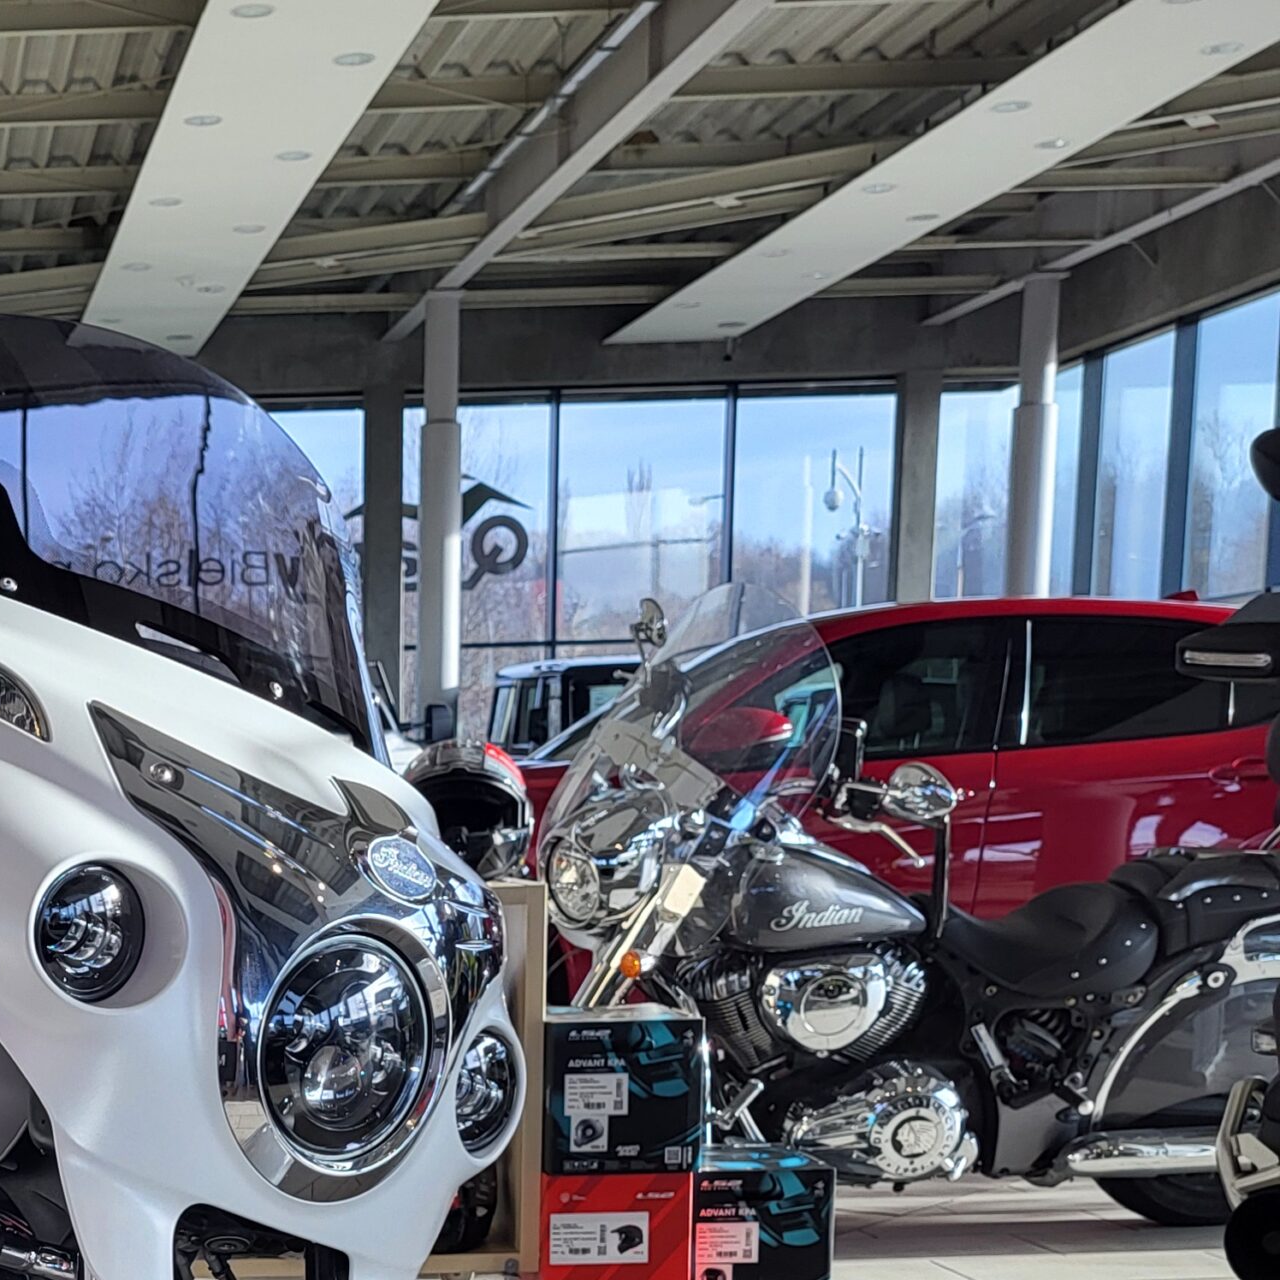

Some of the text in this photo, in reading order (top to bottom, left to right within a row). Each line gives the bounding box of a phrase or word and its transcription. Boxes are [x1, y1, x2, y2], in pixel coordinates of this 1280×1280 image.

[770, 900, 864, 932] Indian
[568, 1059, 605, 1068] ADVANT
[699, 1208, 736, 1217] ADVANT
